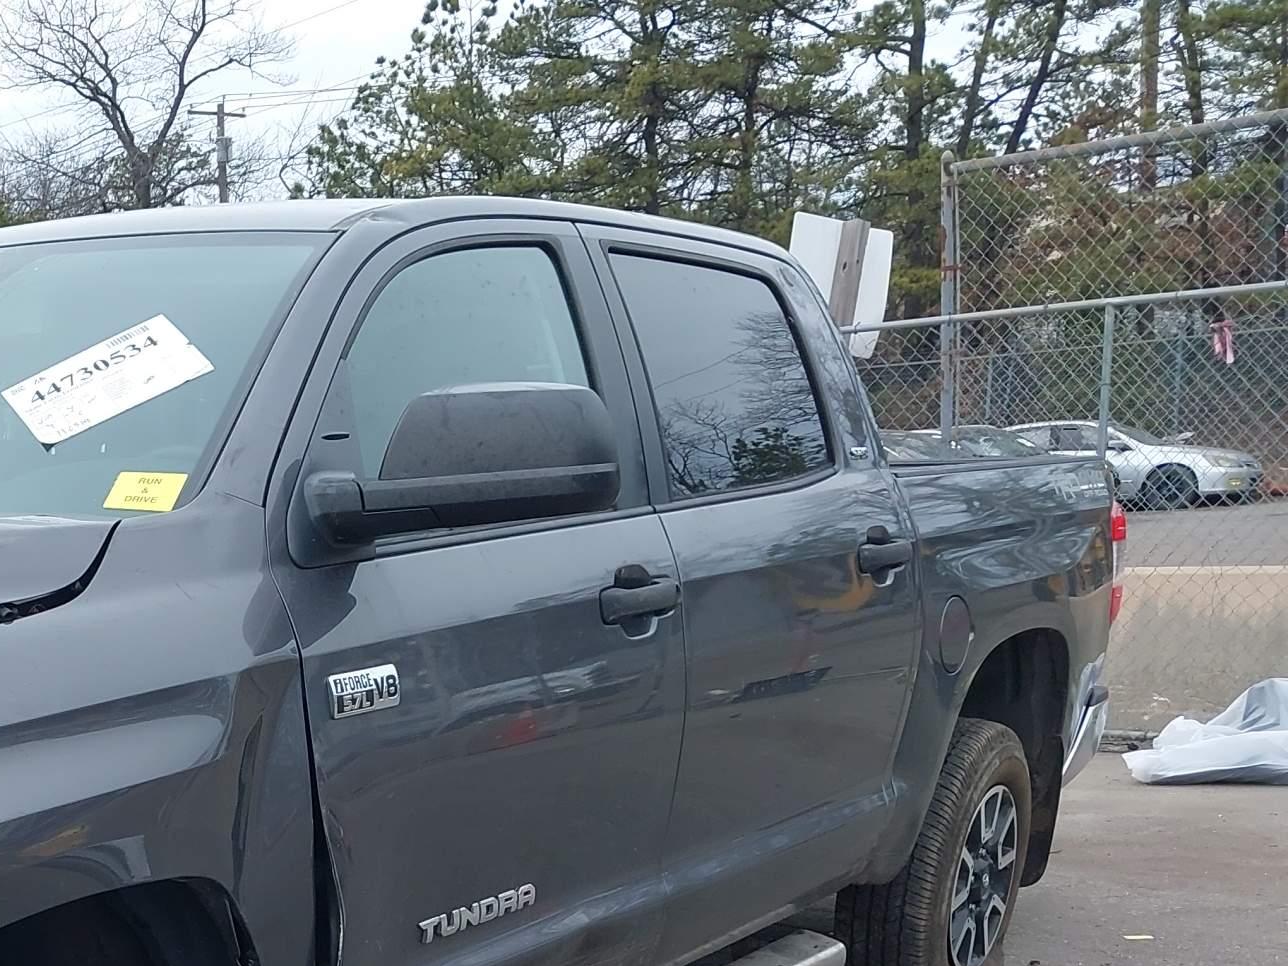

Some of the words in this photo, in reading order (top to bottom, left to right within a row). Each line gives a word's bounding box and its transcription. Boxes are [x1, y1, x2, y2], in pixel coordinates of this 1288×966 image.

[31, 335, 158, 403] 44730534
[138, 477, 162, 485] RUN
[124, 495, 158, 503] DRIVE
[373, 674, 398, 699] V8
[418, 883, 536, 943] TUNDRA
